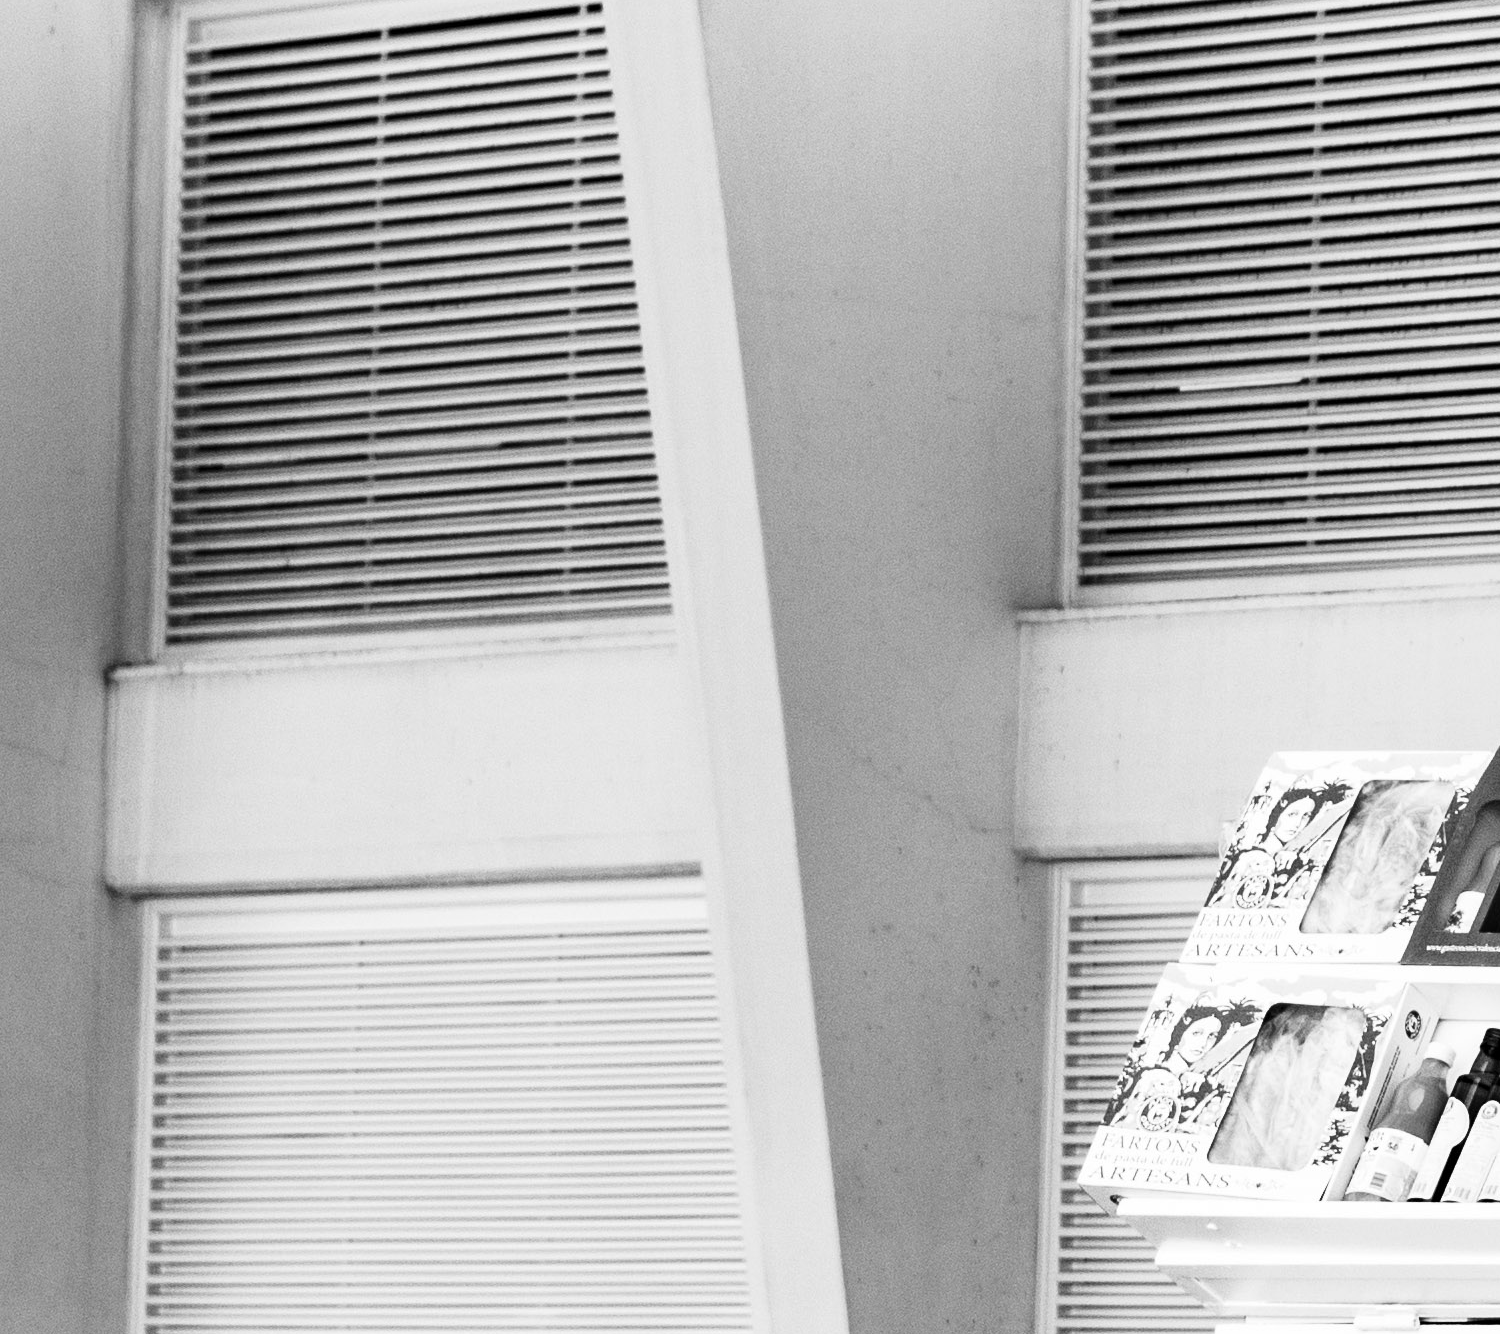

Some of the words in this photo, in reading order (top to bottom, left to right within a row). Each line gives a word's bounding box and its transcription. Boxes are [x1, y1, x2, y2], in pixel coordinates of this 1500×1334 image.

[1198, 913, 1288, 927] FARTONS
[1185, 943, 1316, 957] ARTESANS
[1101, 1132, 1201, 1155] FARTONS
[1088, 1165, 1233, 1189] ARTESANS
